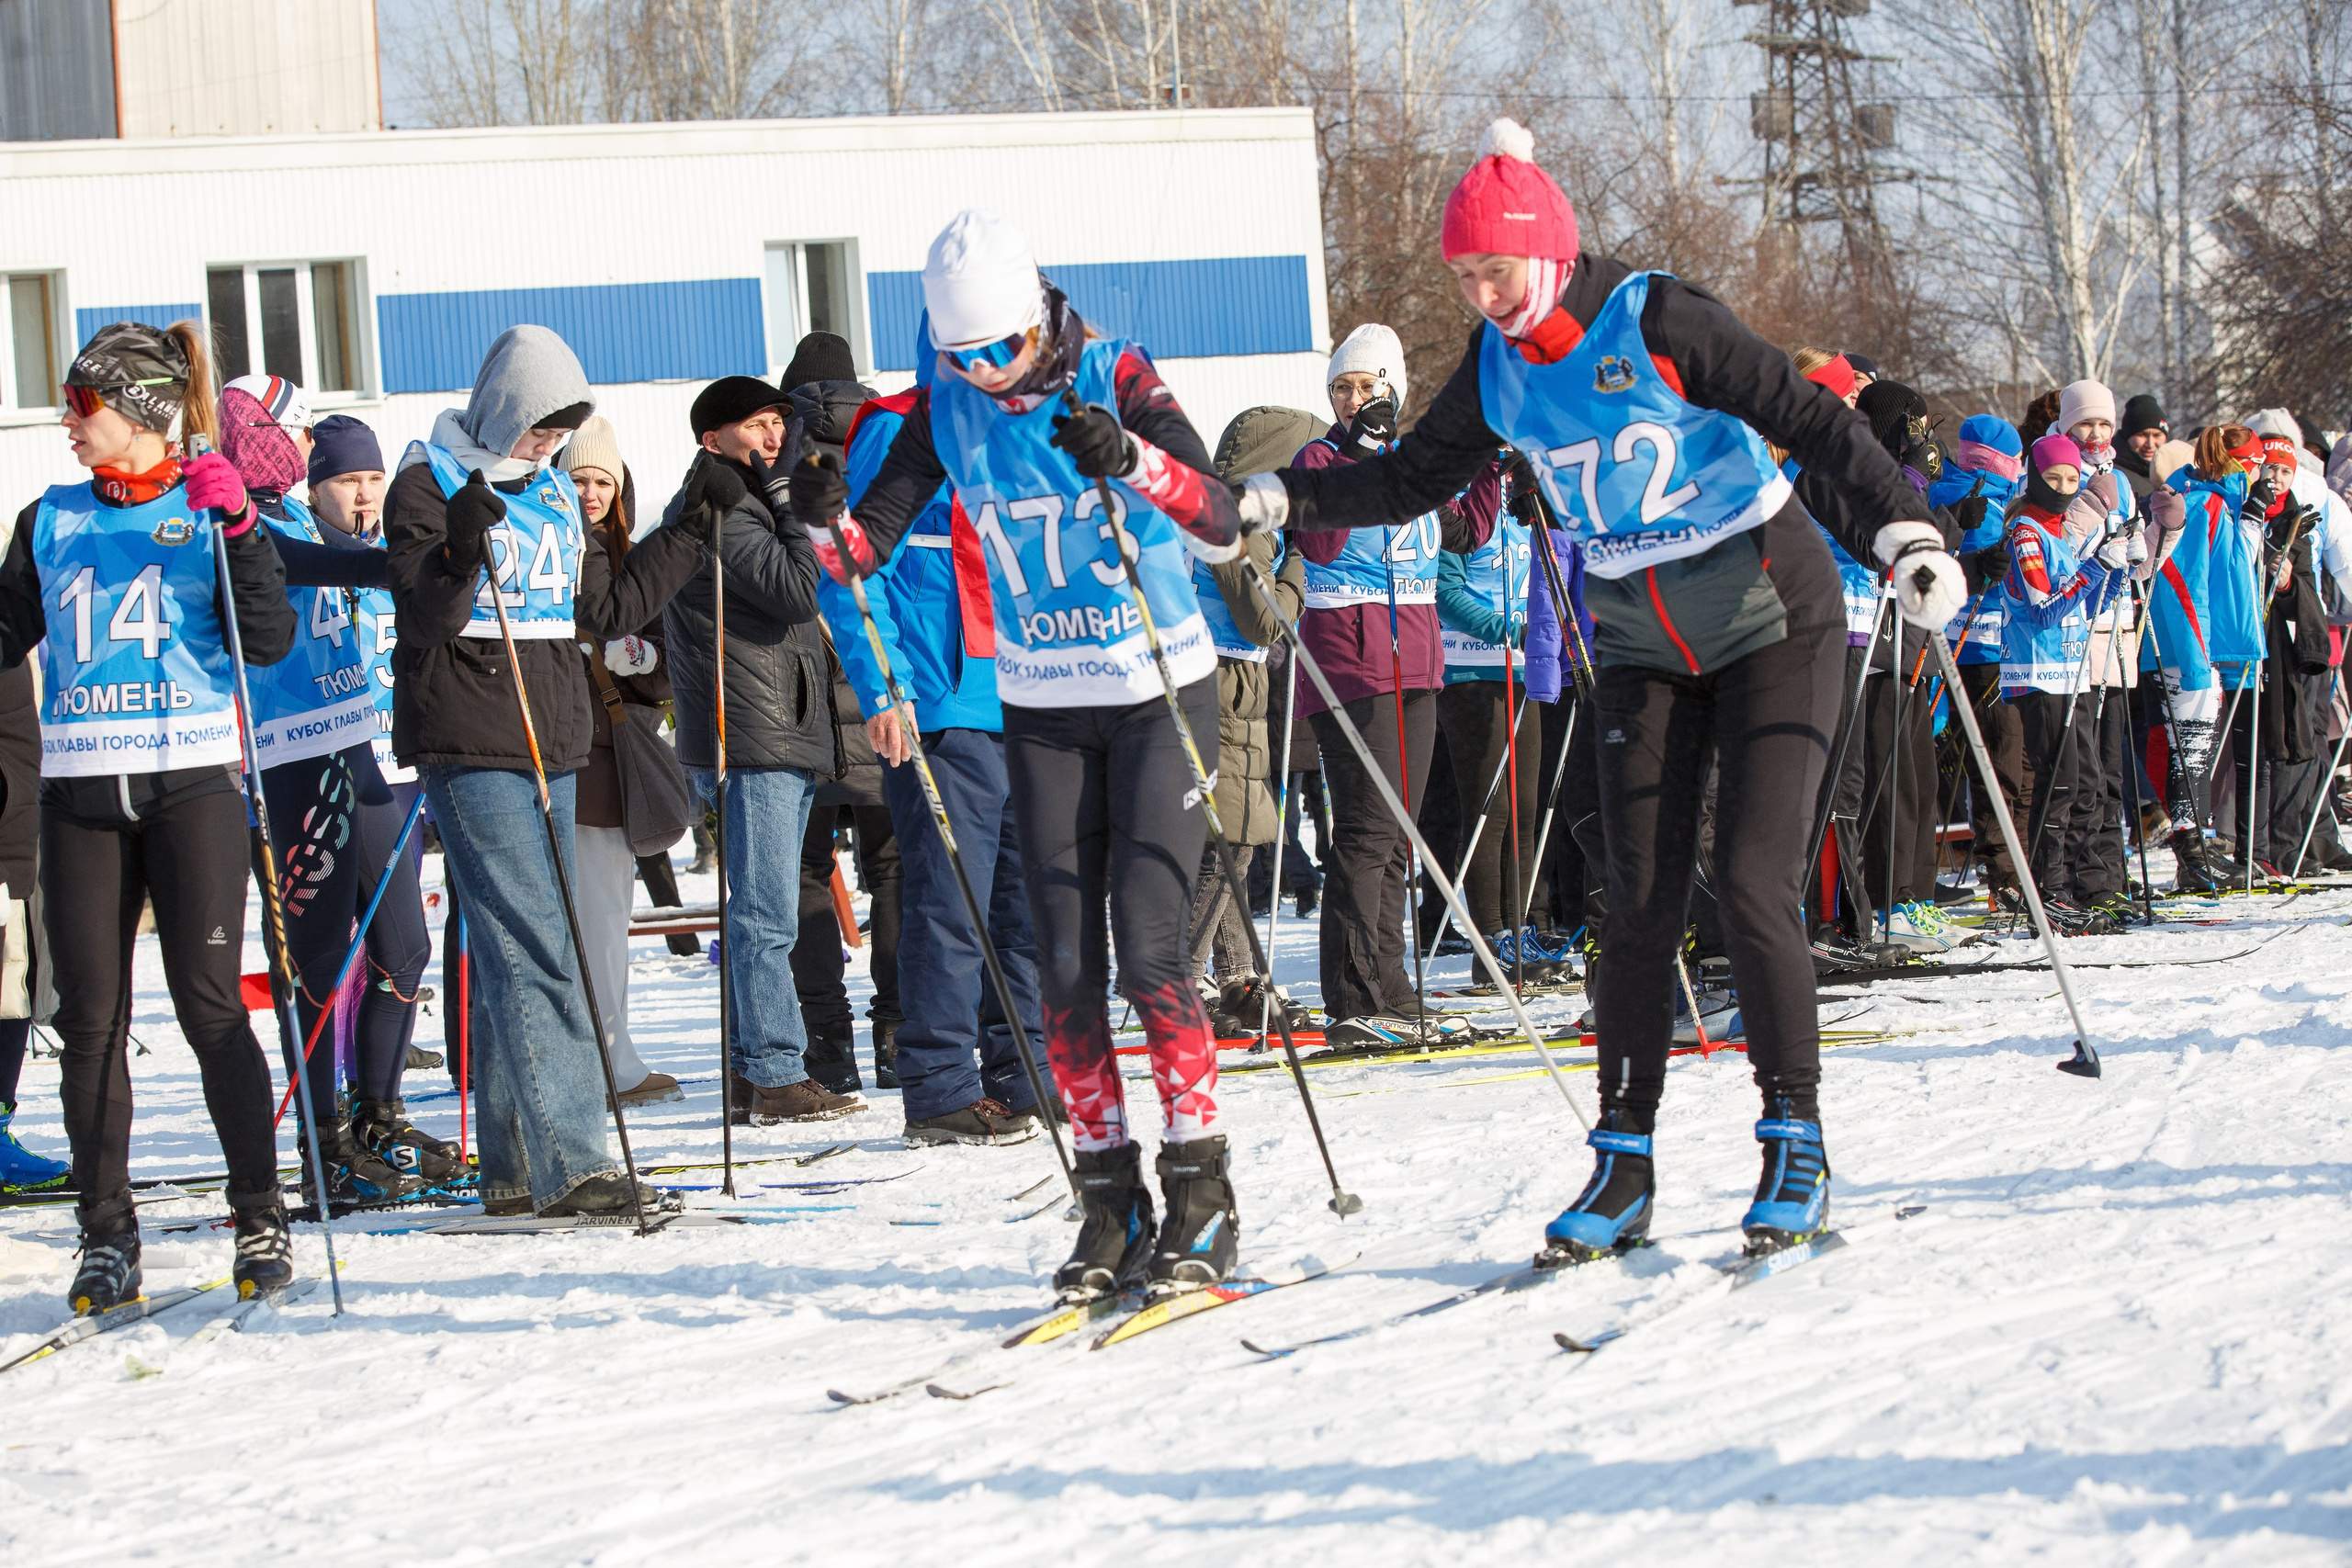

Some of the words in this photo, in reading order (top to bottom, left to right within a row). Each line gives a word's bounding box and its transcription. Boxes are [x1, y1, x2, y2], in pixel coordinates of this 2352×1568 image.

[974, 487, 1140, 598] 173
[2014, 529, 2039, 543] adidas
[475, 522, 575, 608] 24
[59, 563, 171, 664] 14
[1462, 641, 1496, 651] КУБОК
[2037, 671, 2064, 681] КУБОК
[103, 732, 170, 750] ГОРОДА
[176, 724, 235, 745] ТЮМЕНИ
[287, 719, 334, 742] КУБОК
[335, 708, 363, 729] ГЛАВЫ
[1813, 941, 1879, 961] SPINE
